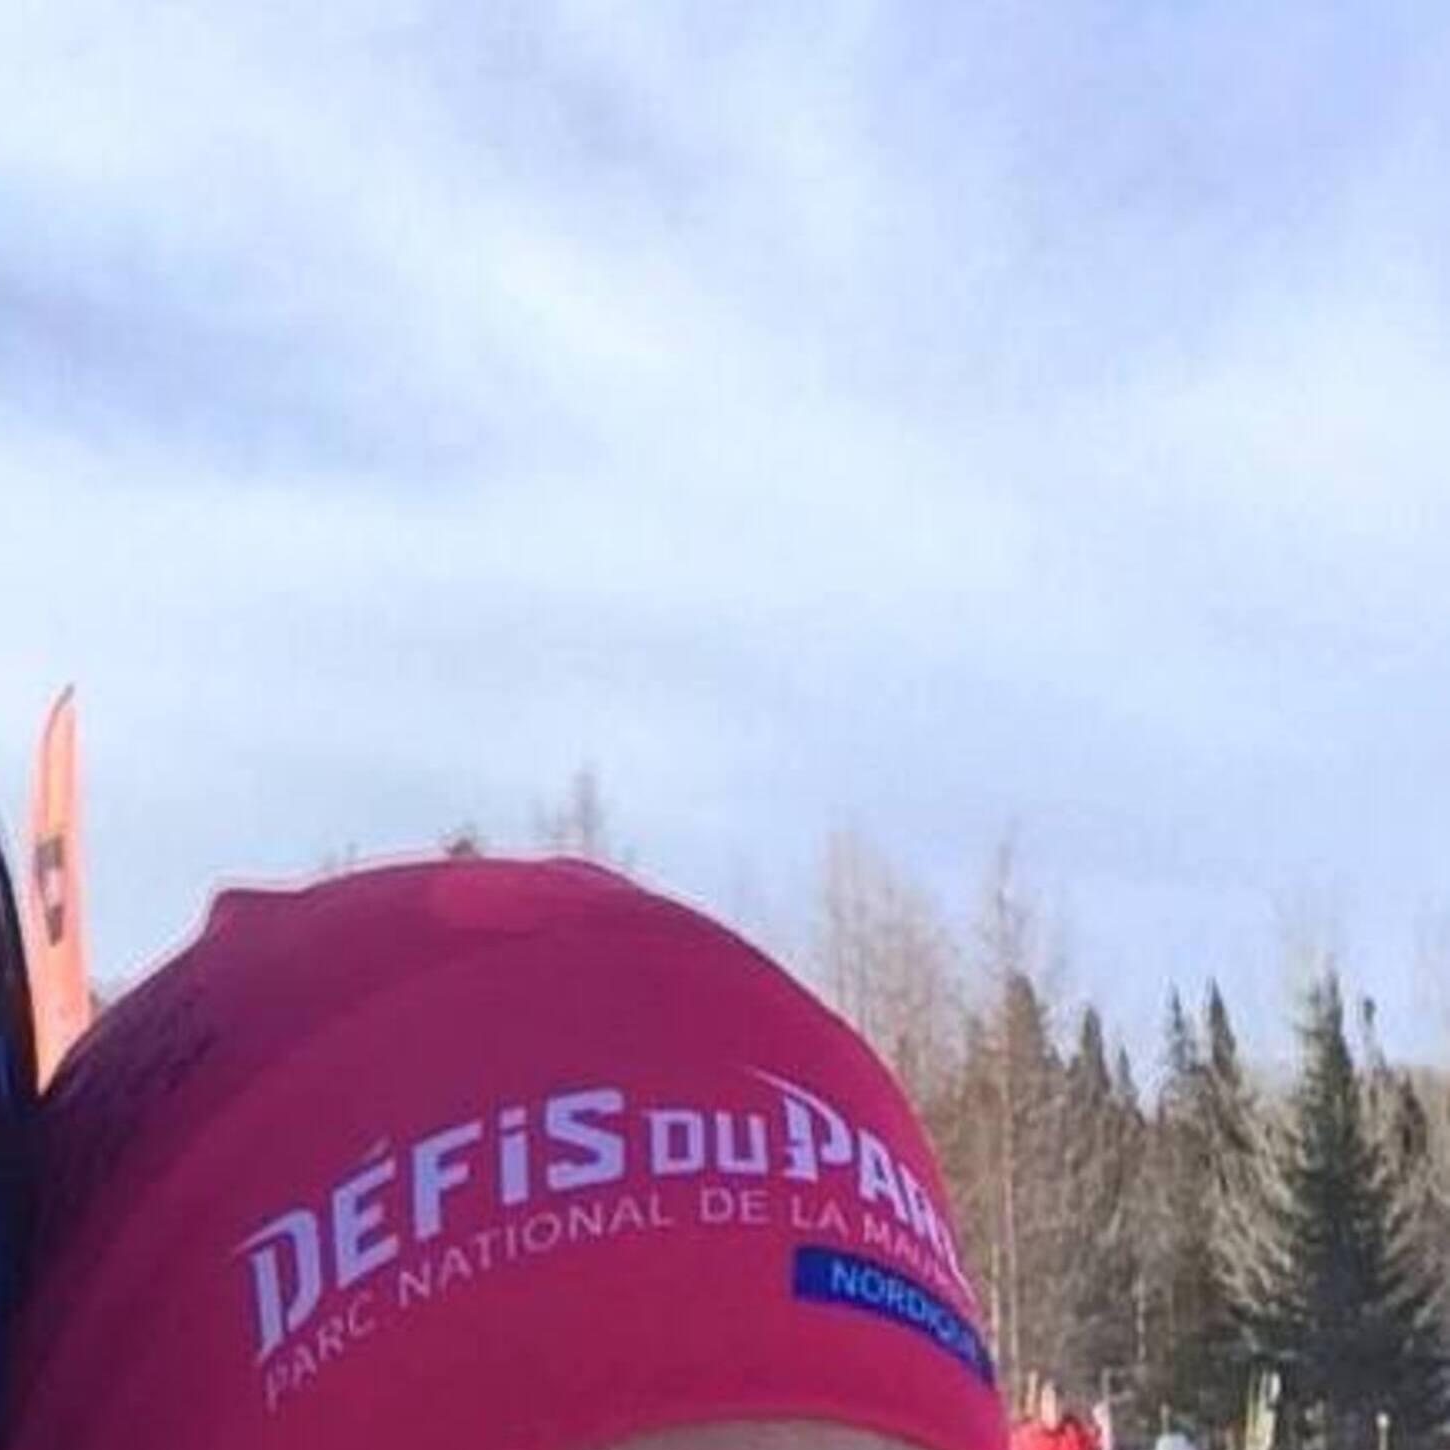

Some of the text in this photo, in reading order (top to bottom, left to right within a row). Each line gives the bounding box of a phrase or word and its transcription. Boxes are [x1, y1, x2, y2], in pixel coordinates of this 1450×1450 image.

[644, 1109, 768, 1176] DU
[264, 1290, 376, 1412] PARC
[398, 1193, 675, 1308] NATIONAL
[701, 1187, 771, 1225] DE
[790, 1195, 848, 1237] LA
